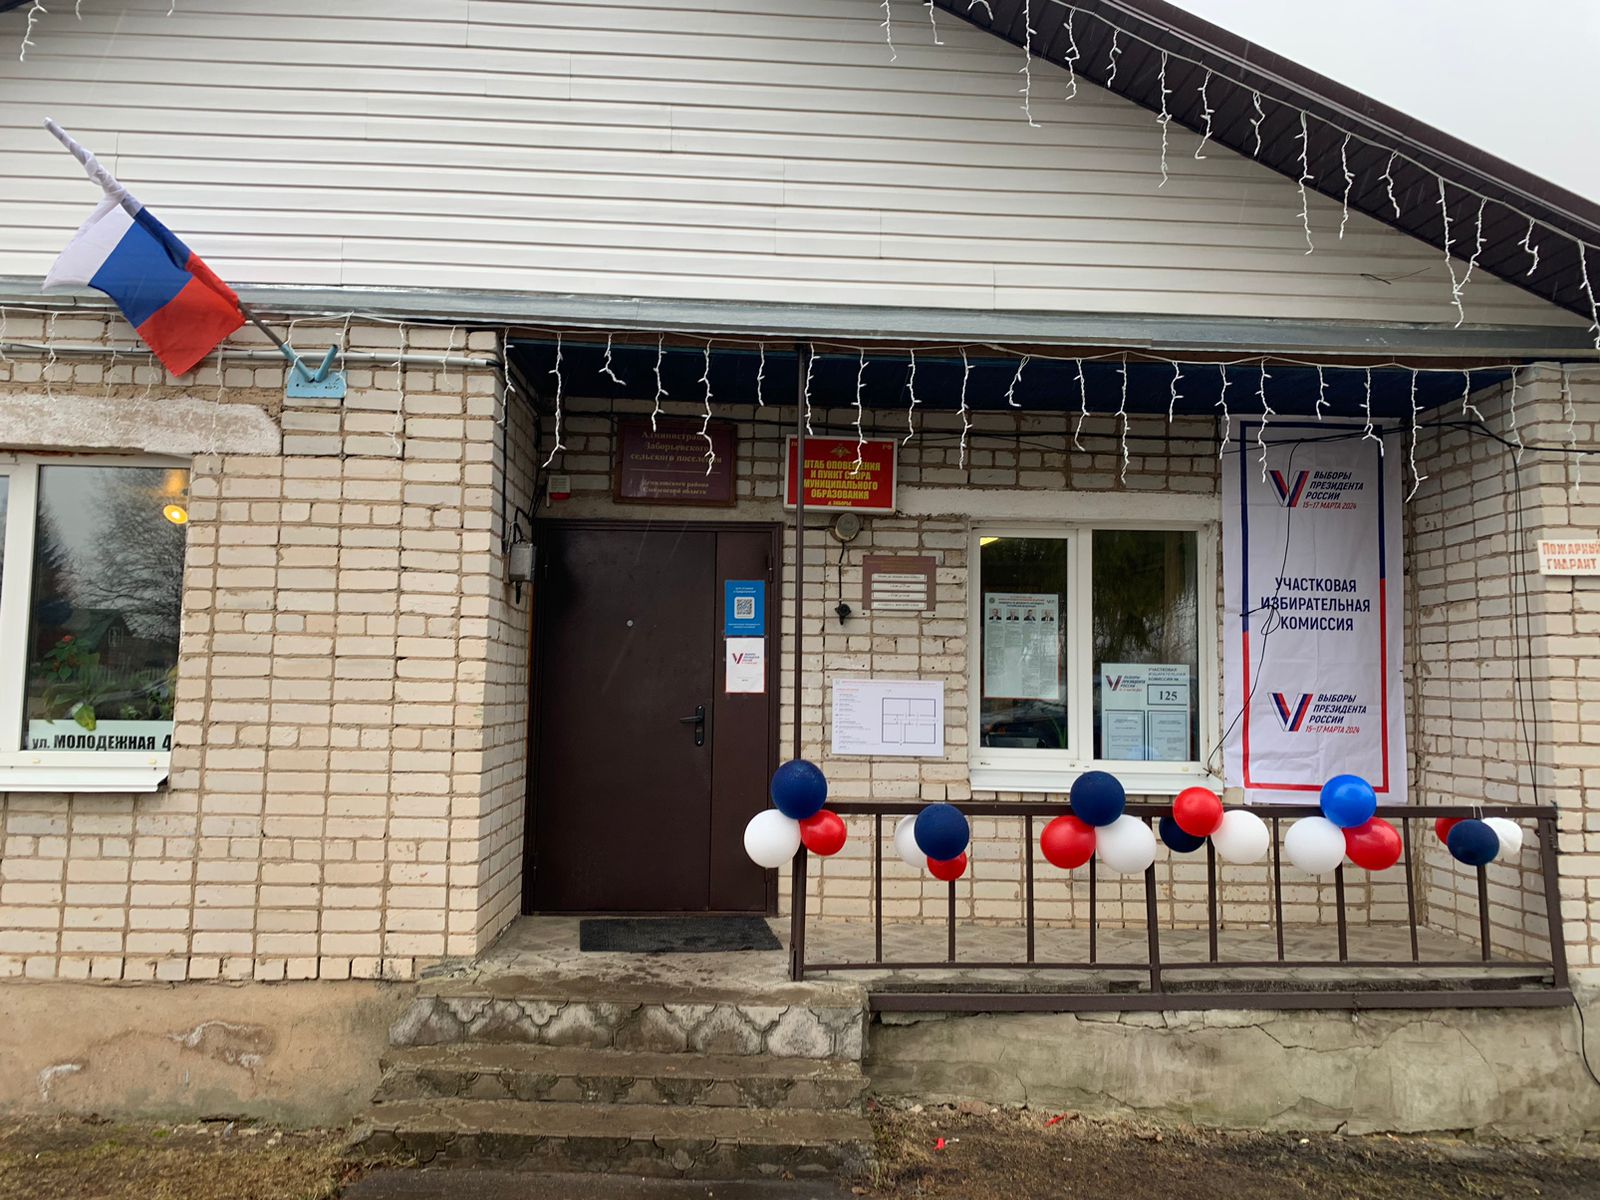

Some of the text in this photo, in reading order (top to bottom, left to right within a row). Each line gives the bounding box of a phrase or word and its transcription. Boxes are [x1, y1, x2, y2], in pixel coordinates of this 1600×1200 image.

[811, 470, 816, 478] И
[818, 470, 843, 479] ПУНКТ
[1313, 471, 1352, 480] ВЫБОРЫ
[803, 479, 878, 490] МУНИЦИПАЛЬНОГО
[1309, 482, 1364, 491] ПРЕЗИДЕНТА
[811, 489, 869, 499] ОБРАЗОВАНИЯ
[1305, 491, 1341, 500] РОССИИ
[1547, 558, 1597, 570] ГИДРАНТ
[1275, 577, 1357, 592] УЧАСТКОВАЯ
[1260, 596, 1371, 612] ИЗБИРАТЕЛЬНАЯ
[1280, 616, 1354, 631] КОМИССИЯ
[1159, 690, 1178, 701] 125
[1317, 694, 1357, 703] ВЫБОРЫ
[1313, 704, 1367, 714] ПРЕЗИДЕНТА
[1308, 715, 1344, 724] РОССИИ
[1323, 725, 1344, 733] МАРТА
[1345, 726, 1360, 734] 2024
[32, 738, 50, 750] ул.
[53, 734, 155, 751] МОЛОДЕЖНАЯ
